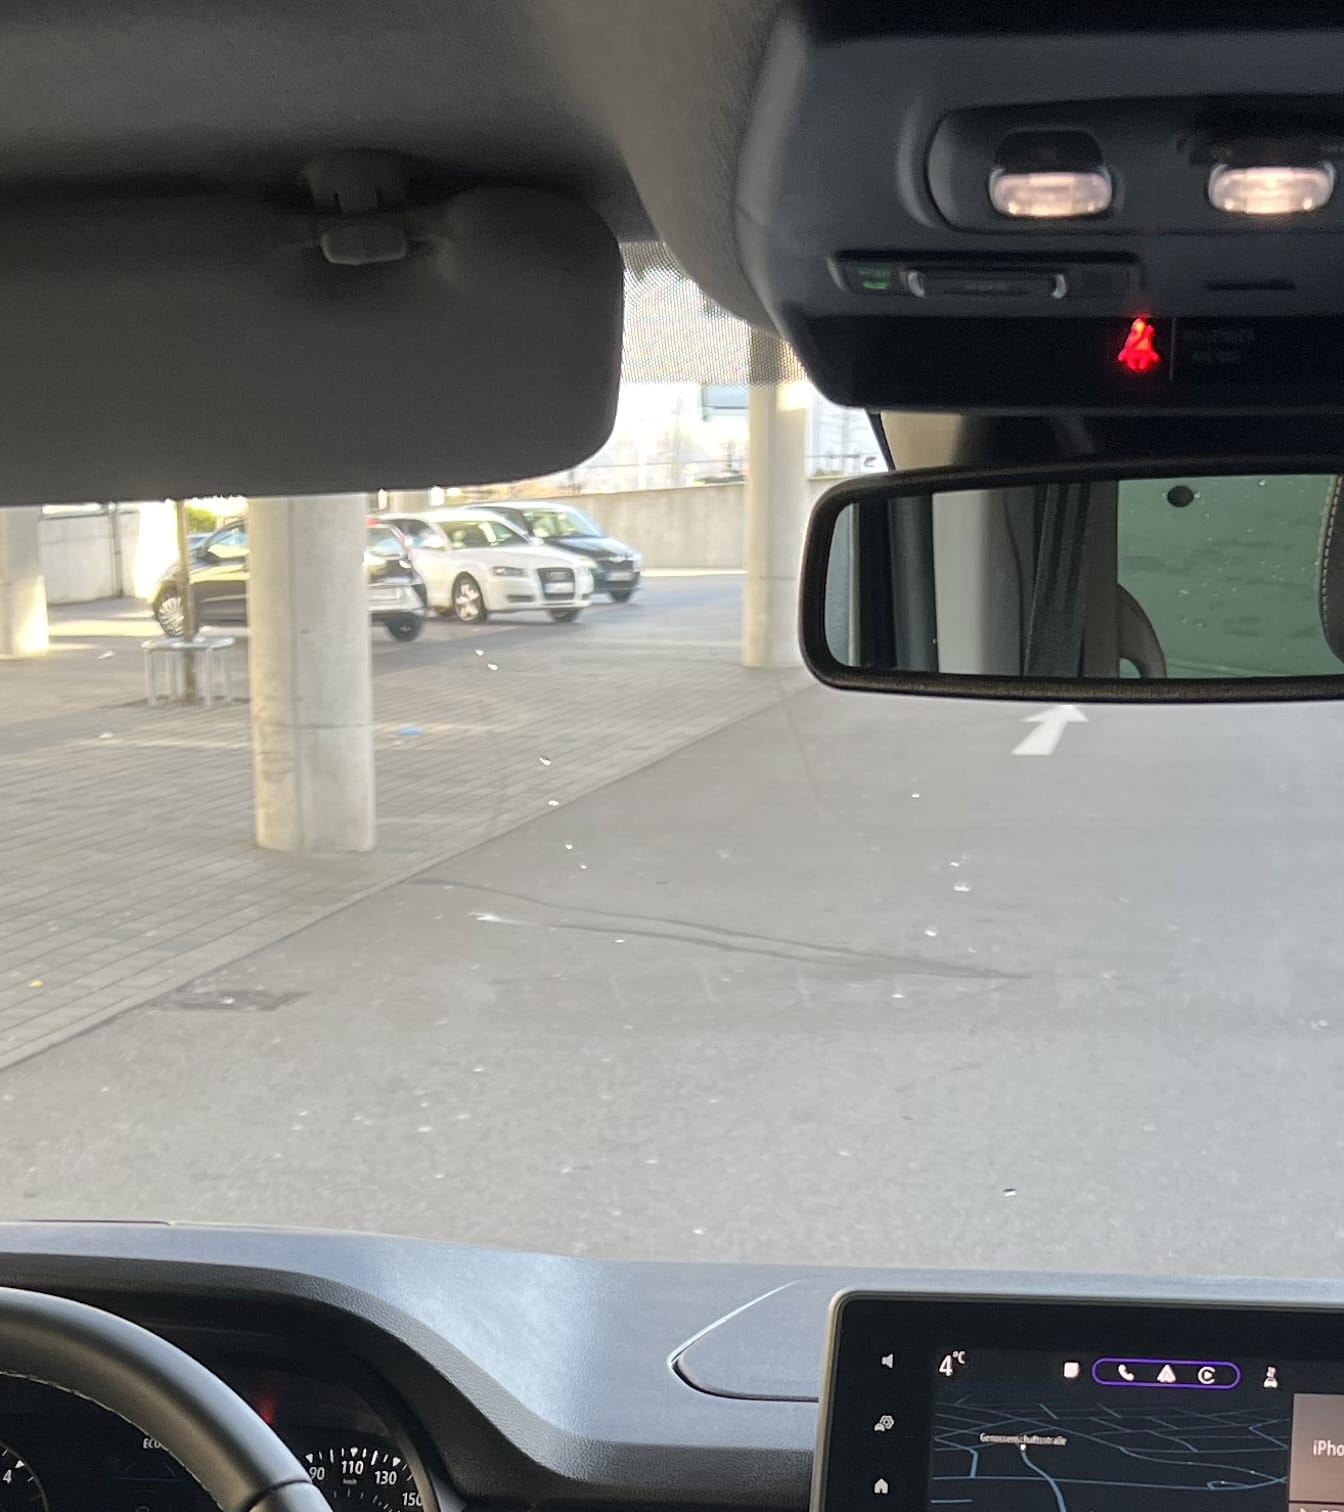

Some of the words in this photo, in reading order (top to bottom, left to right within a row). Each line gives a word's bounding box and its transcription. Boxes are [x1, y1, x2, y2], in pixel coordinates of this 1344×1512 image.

[308, 1466, 326, 1481] 90
[341, 1460, 365, 1475] 110
[2, 1469, 12, 1484] 4
[374, 1470, 398, 1486] 130
